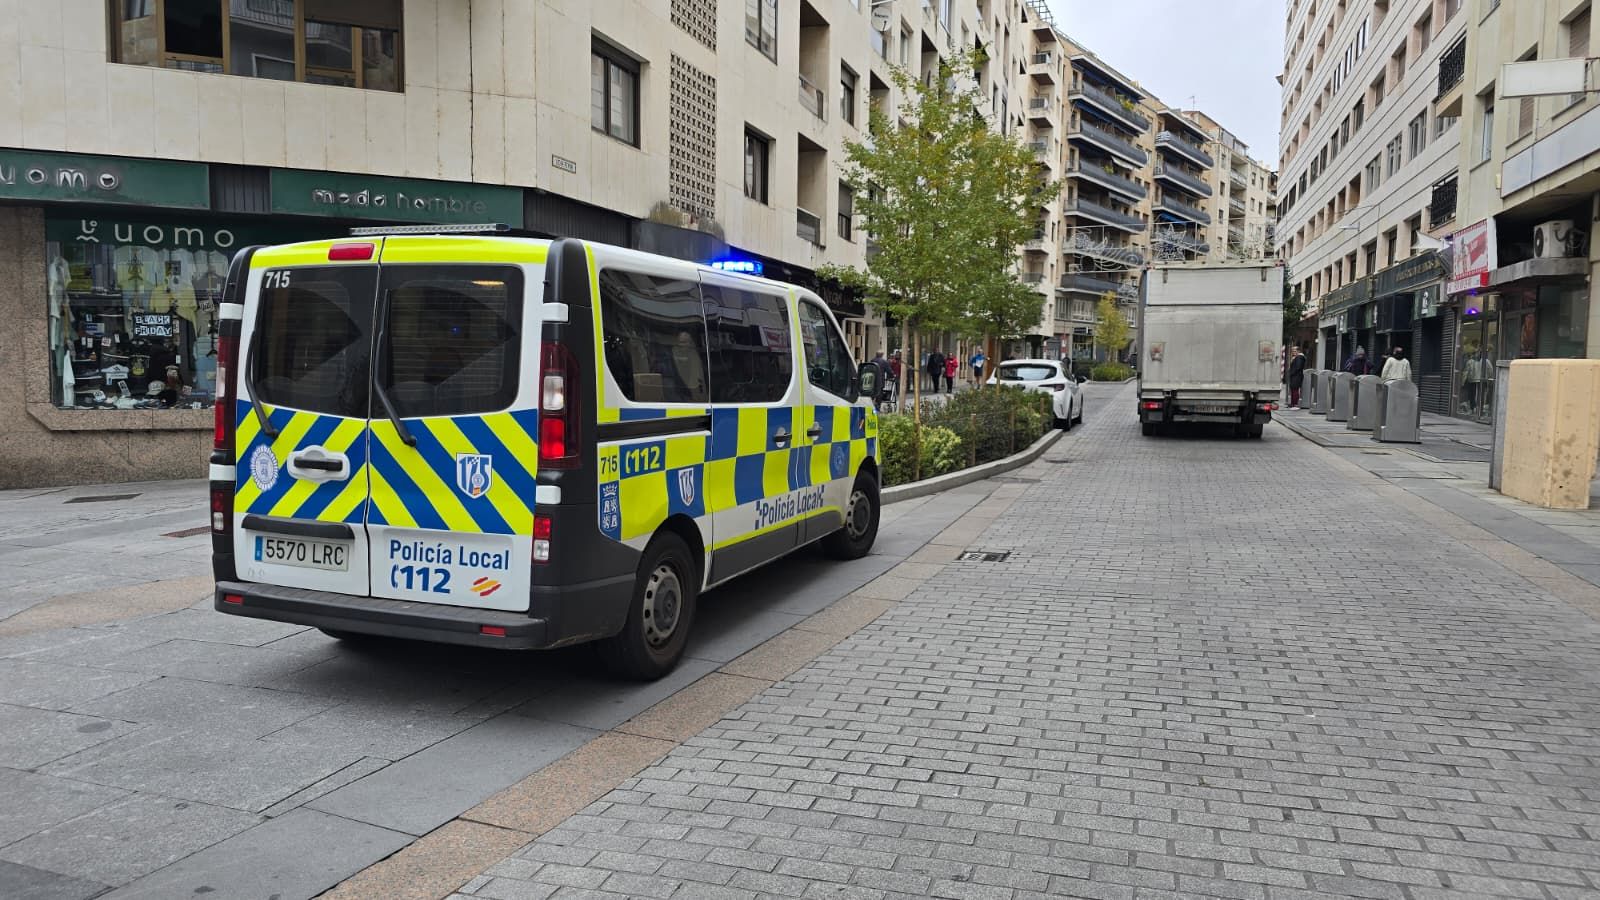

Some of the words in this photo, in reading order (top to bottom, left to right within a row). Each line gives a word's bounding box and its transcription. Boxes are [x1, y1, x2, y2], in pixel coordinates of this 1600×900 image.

[396, 193, 487, 214] hombre
[114, 223, 235, 247] uomo
[265, 270, 291, 289] 715
[135, 315, 171, 324] BLACK
[135, 326, 172, 336] FRIDAY
[600, 455, 618, 474] 715
[630, 446, 660, 472] 112
[762, 494, 795, 527] Policía
[266, 539, 306, 562] 5570
[312, 543, 344, 566] LRC
[389, 539, 452, 565] Policía
[459, 545, 509, 571] Local
[400, 565, 451, 594] 112
